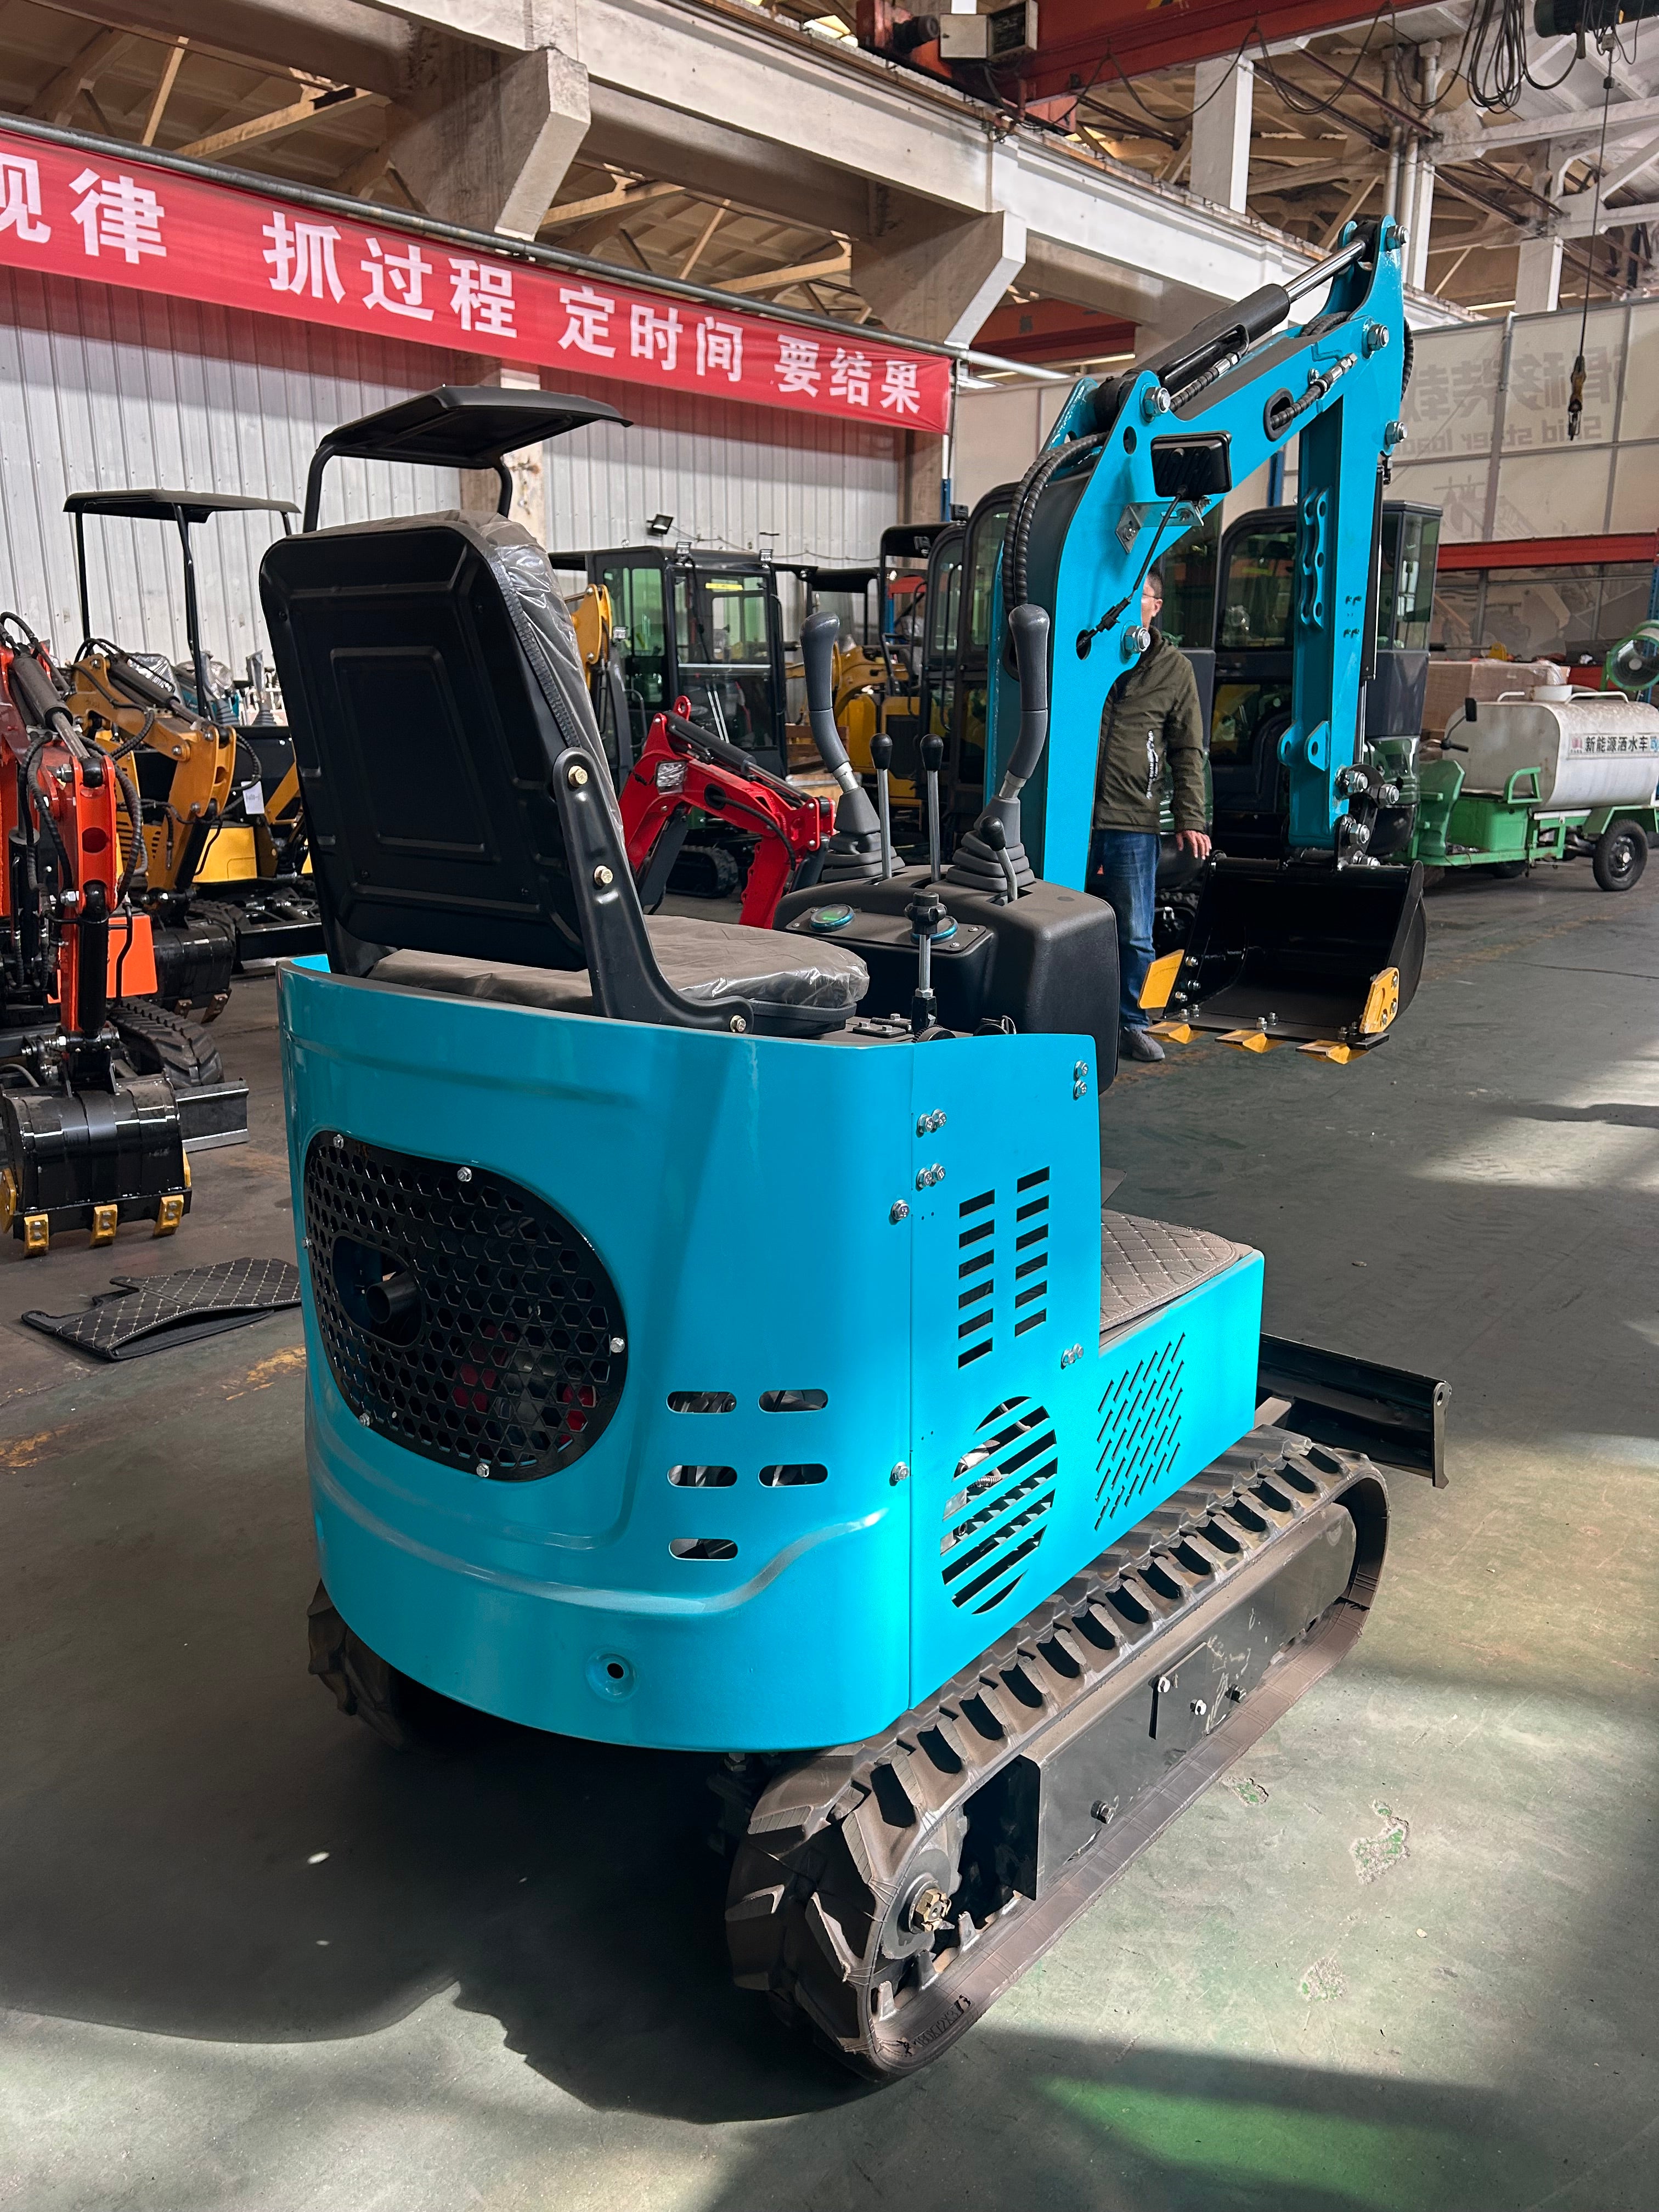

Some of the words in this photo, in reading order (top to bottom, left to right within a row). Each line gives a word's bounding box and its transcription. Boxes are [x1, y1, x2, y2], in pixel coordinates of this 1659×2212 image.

[262, 211, 517, 338] 抓过程
[557, 286, 744, 382] 定时间
[774, 334, 921, 414] 要结果
